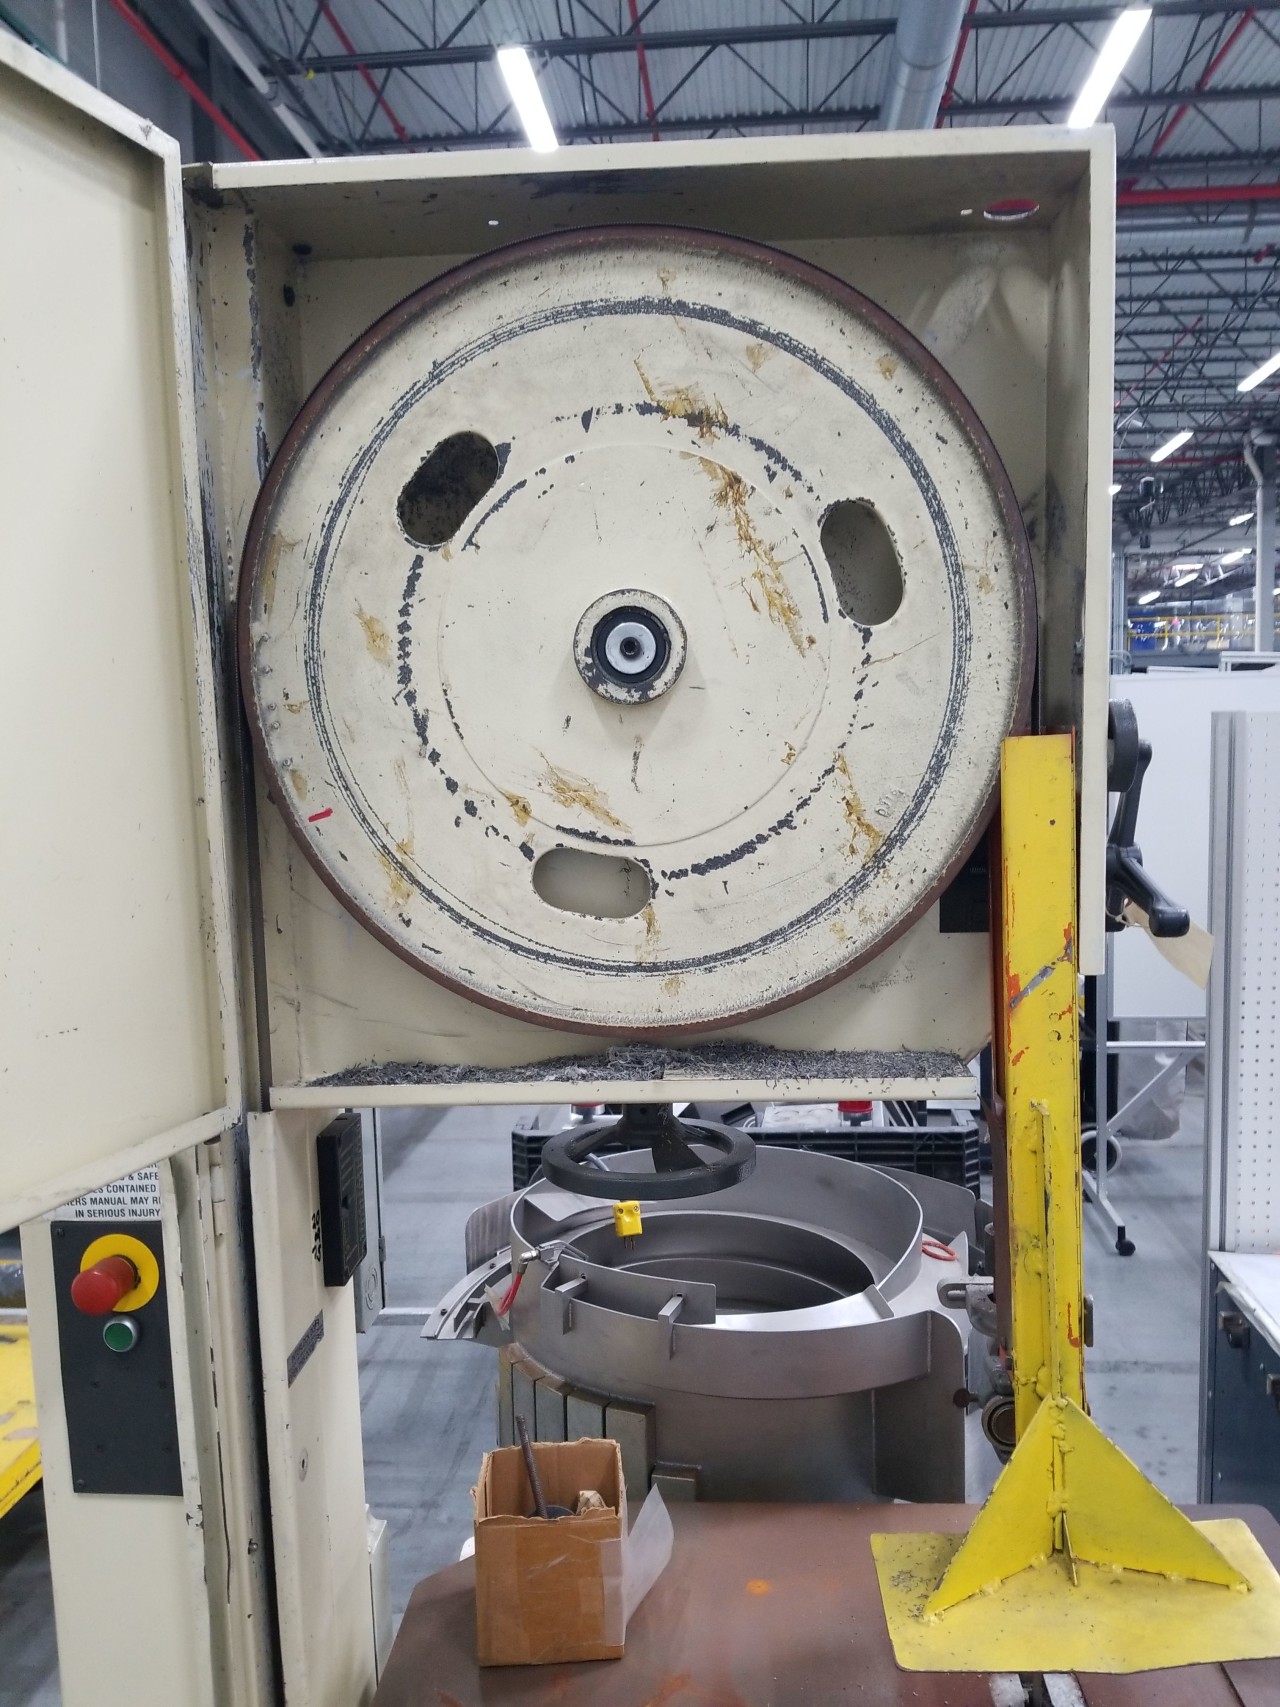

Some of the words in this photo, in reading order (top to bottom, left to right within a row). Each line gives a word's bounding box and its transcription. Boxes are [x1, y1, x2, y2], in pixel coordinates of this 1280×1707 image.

[106, 1184, 157, 1194] CONTAINED
[90, 1196, 128, 1206] MANUAL
[130, 1196, 151, 1205] MAY
[75, 1209, 85, 1218] IN
[87, 1208, 126, 1218] SERIOUS
[128, 1208, 161, 1217] INJURY
